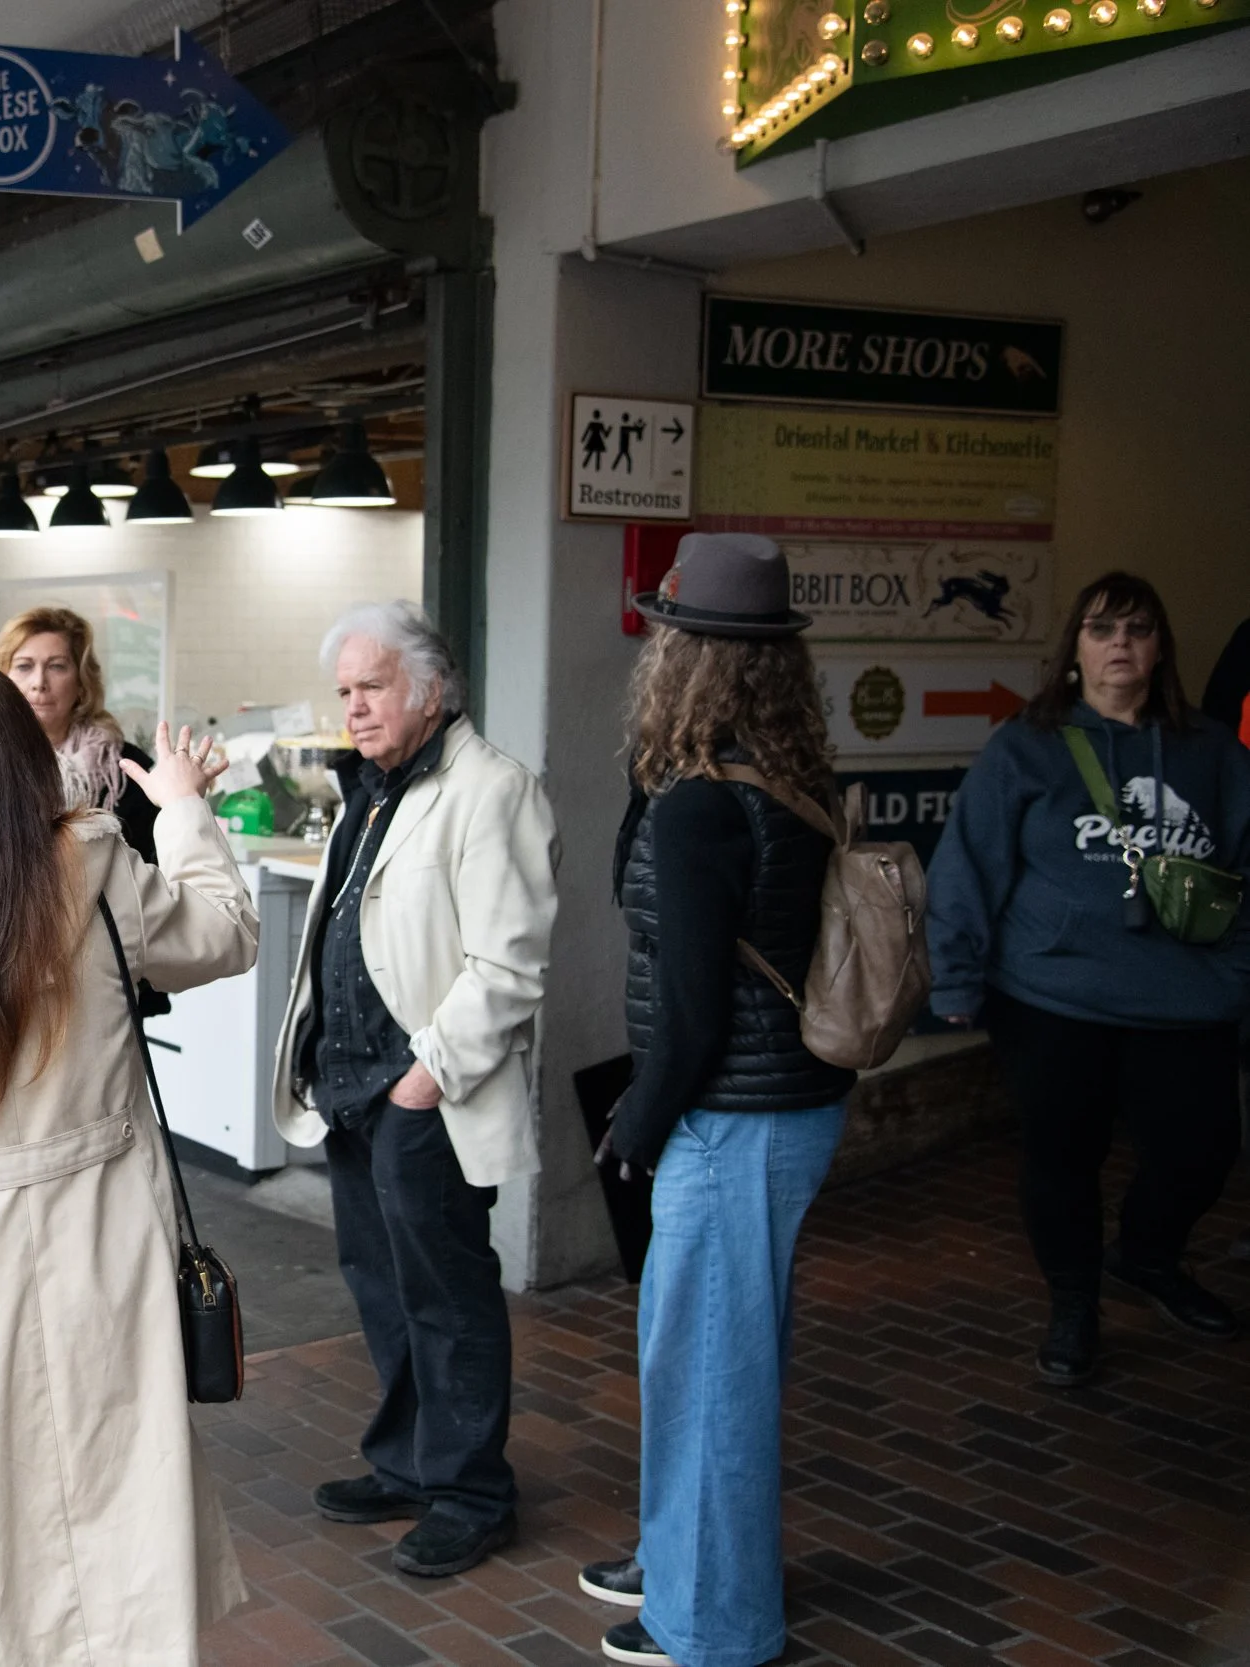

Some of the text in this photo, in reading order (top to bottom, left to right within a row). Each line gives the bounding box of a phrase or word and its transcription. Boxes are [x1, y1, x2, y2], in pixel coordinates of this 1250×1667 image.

[722, 324, 989, 382] MORE SHOPS
[775, 424, 852, 452] Oriental
[855, 429, 921, 454] Market
[579, 484, 682, 511] Restrooms
[851, 574, 912, 608] BOX
